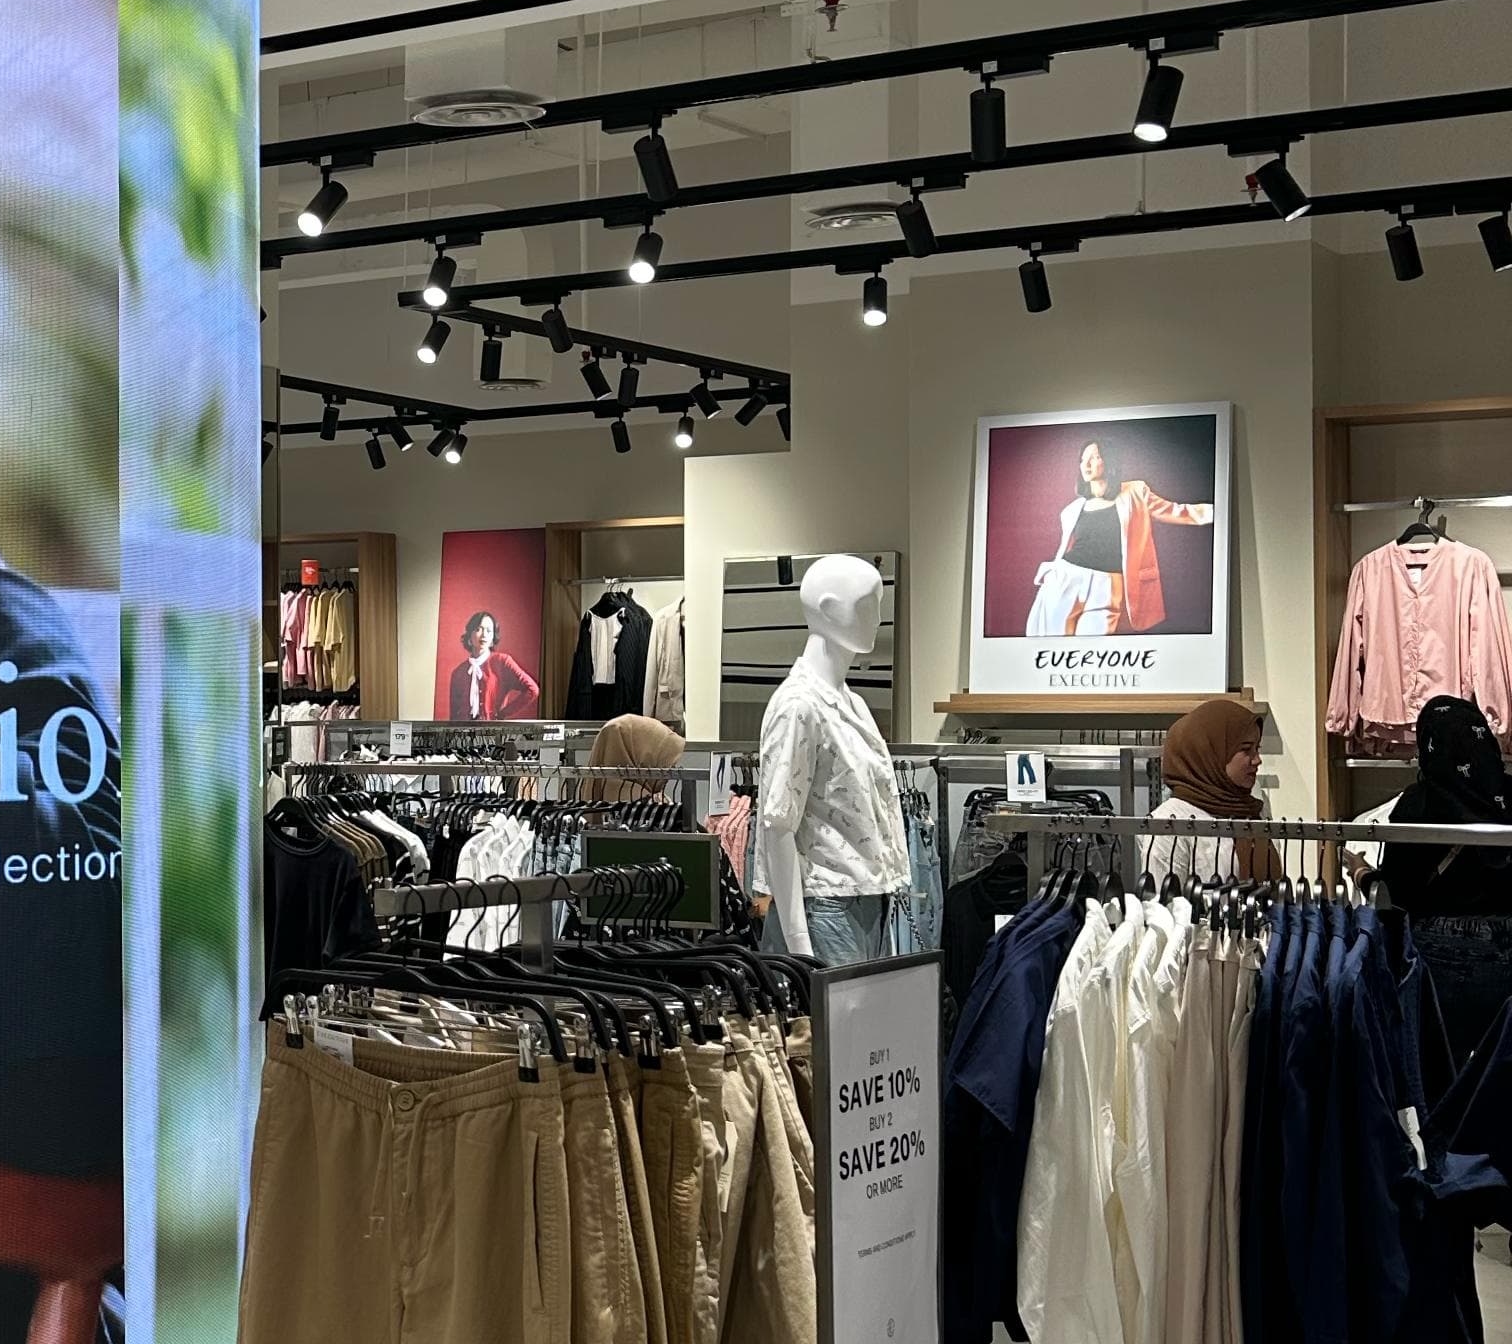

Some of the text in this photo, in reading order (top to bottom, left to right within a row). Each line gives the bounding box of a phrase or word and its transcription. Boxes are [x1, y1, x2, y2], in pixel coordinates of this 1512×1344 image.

[1034, 649, 1158, 670] EVERYONE
[1048, 673, 1141, 688] EXECUTIVE
[869, 1049, 885, 1066] BUY
[839, 1065, 921, 1114] SAVE 10%
[869, 1111, 893, 1132] BUY 2
[839, 1129, 925, 1181] SAVE 20%
[866, 1174, 904, 1200] OR MORE
